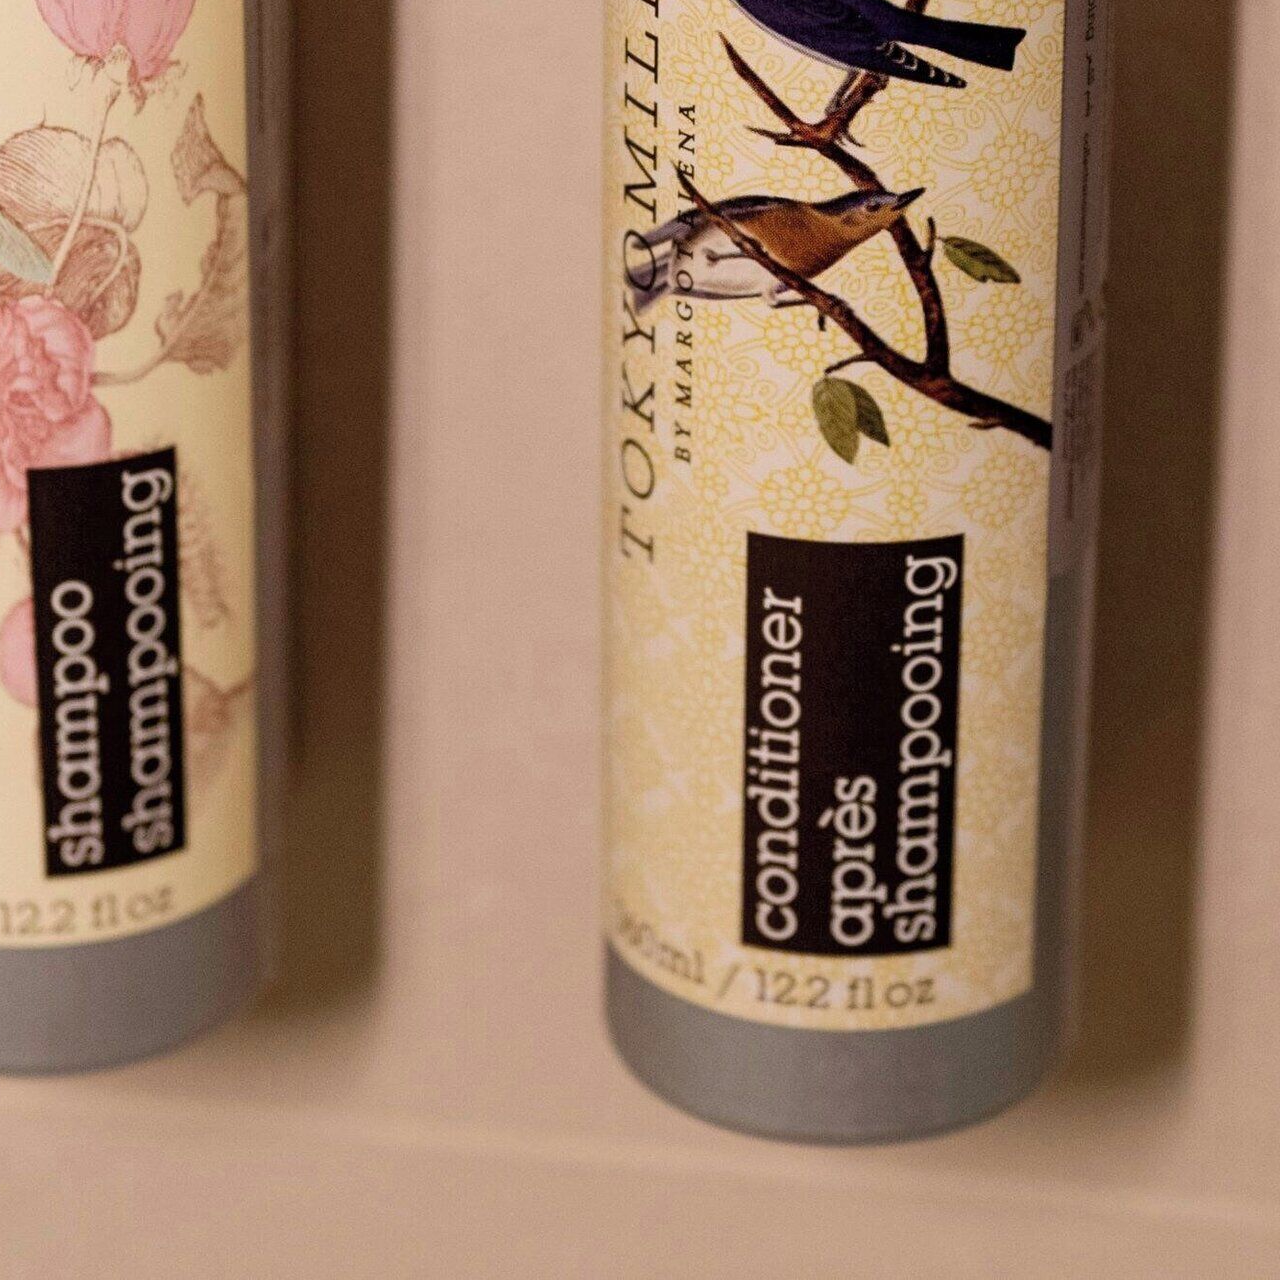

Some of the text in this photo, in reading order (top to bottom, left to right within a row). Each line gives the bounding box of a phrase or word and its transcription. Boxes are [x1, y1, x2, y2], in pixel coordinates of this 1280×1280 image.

[674, 241, 694, 409] MARGOT
[674, 421, 692, 464] BY
[47, 579, 111, 867] shampoo
[114, 467, 180, 854] shampooing
[747, 587, 804, 942] conditioner
[883, 554, 959, 944] shampooing
[817, 775, 889, 948] après
[846, 977, 874, 1010] fl
[884, 978, 935, 1009] oz
